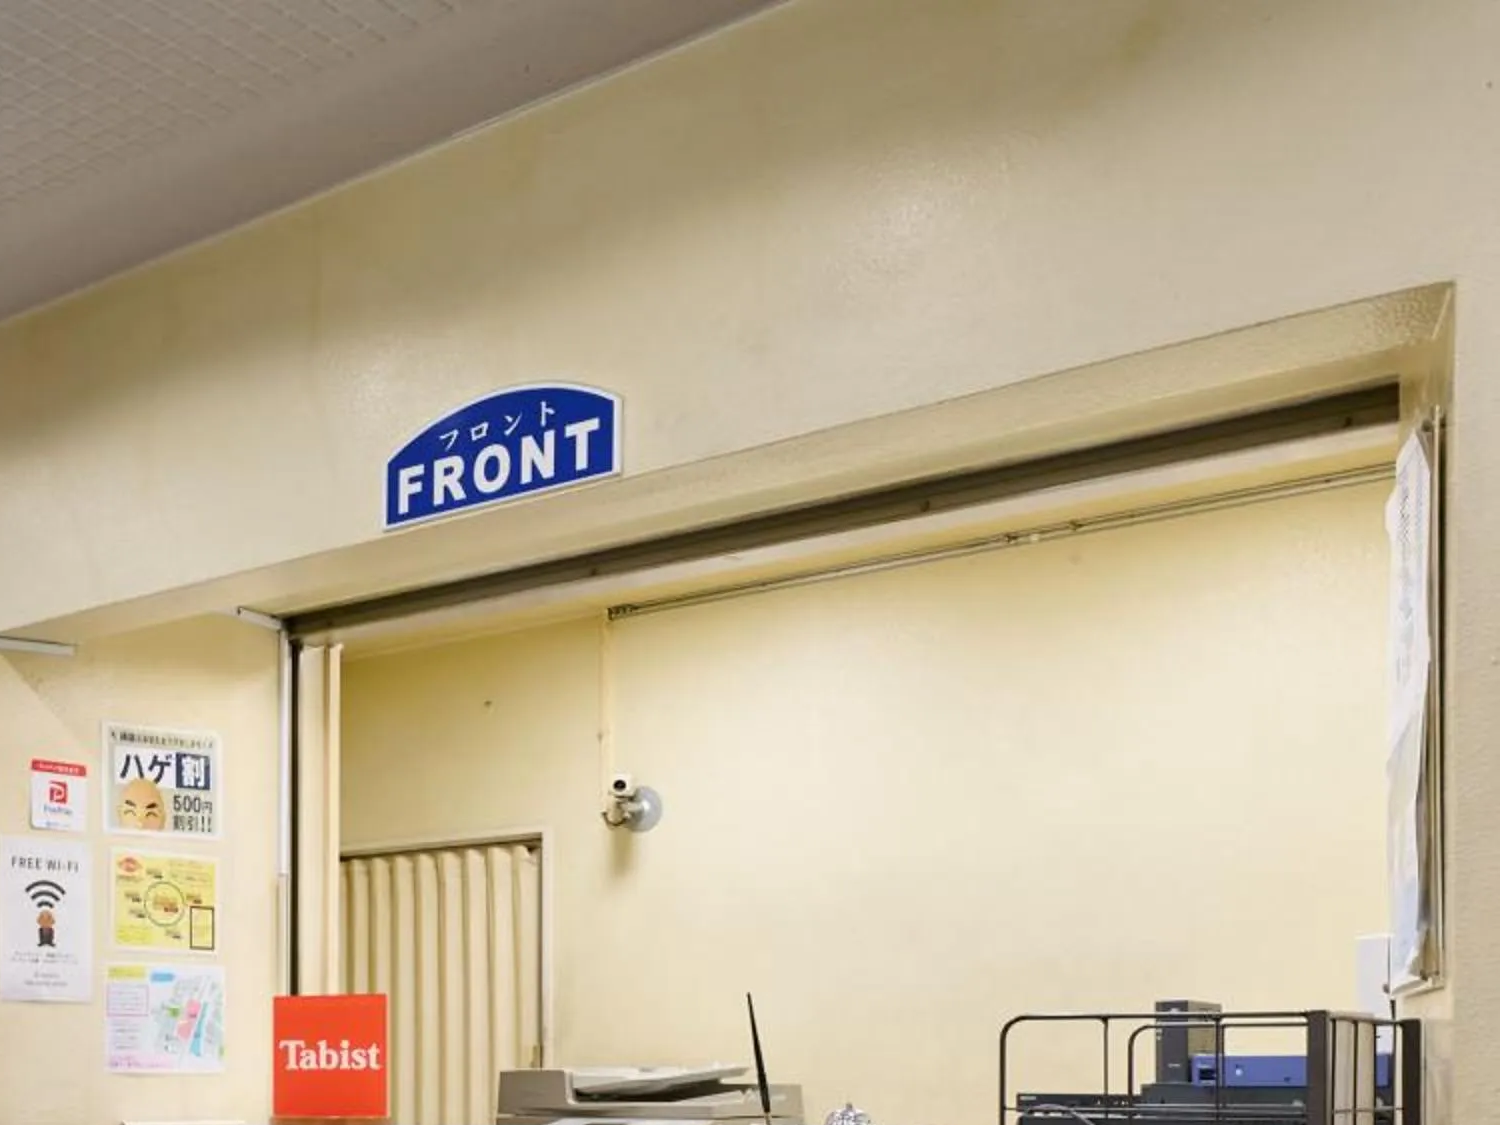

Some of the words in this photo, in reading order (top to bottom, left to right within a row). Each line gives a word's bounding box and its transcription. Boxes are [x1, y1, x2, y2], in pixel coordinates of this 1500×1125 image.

[440, 400, 556, 452] フロント
[398, 418, 600, 515] FRONT
[173, 795, 212, 813] 500円
[11, 856, 41, 871] FREE
[279, 1039, 381, 1071] Tabist
